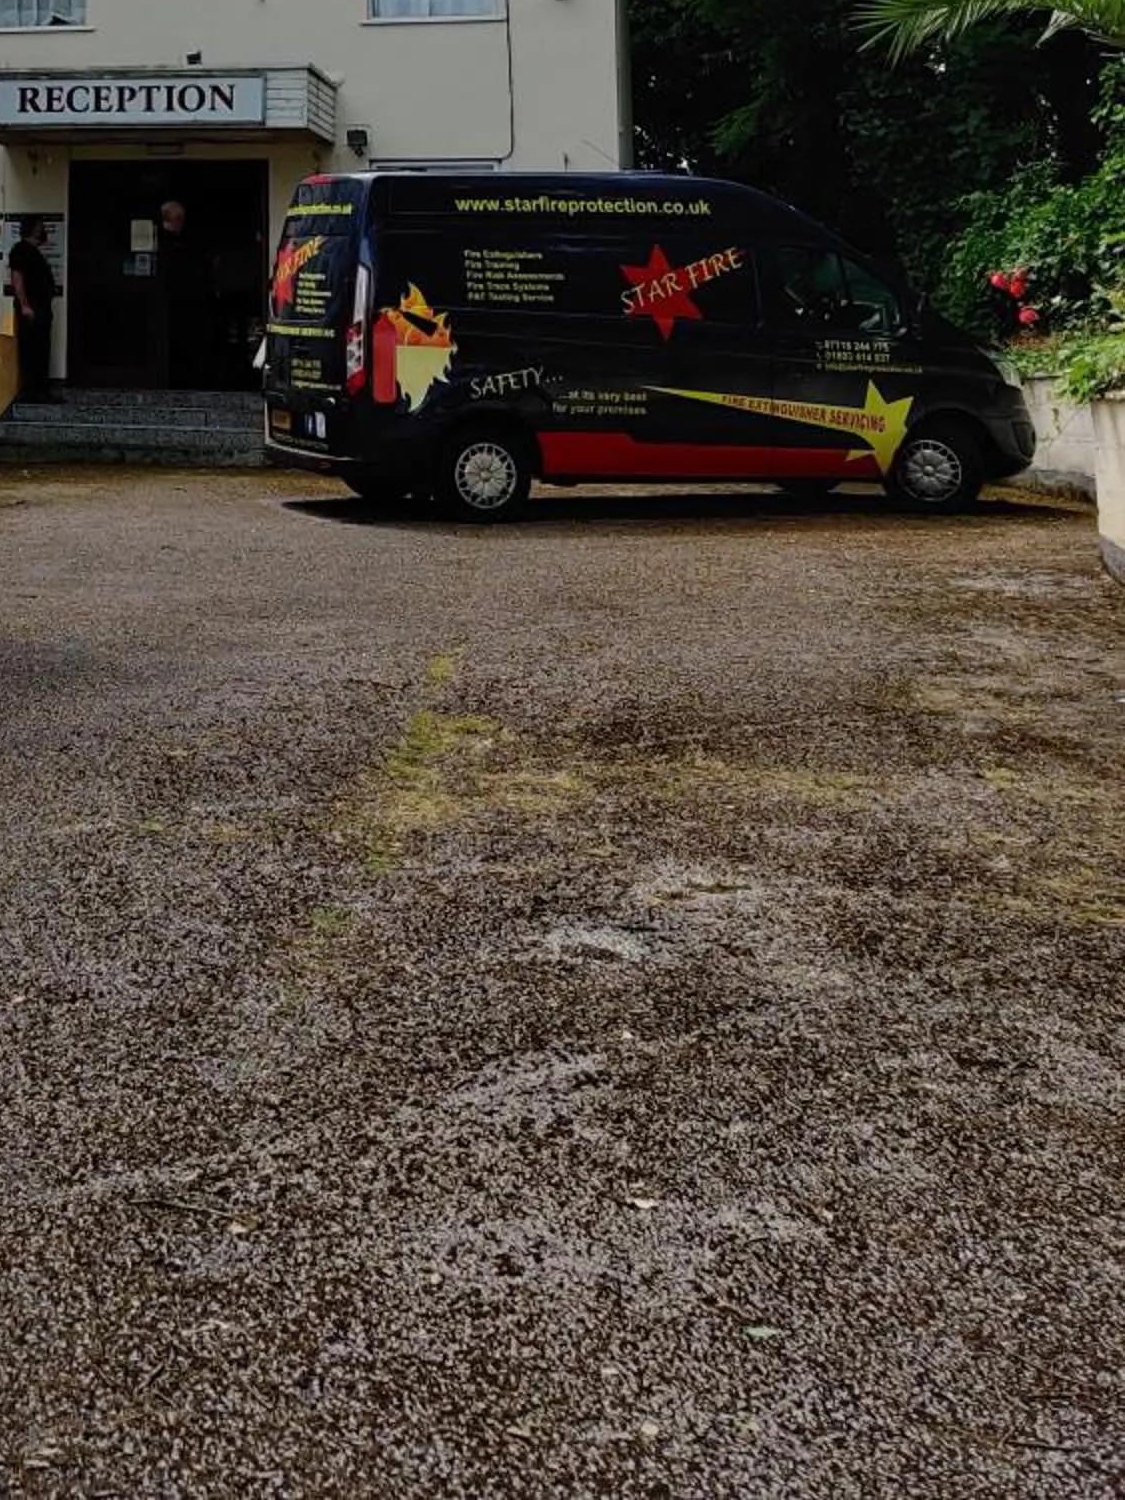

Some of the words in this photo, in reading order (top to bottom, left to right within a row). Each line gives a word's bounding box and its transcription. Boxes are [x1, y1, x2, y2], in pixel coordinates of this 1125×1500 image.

[17, 84, 235, 113] RECEPTION
[455, 196, 712, 216] www.starfireprotection.co.uk
[463, 250, 481, 259] Fire
[464, 260, 481, 269] Fire
[484, 260, 520, 271] Training
[466, 270, 484, 280] Fire
[485, 271, 504, 280] Risk
[619, 272, 684, 314] STAR
[685, 246, 743, 289] FIRE
[467, 281, 484, 291] Fire
[512, 282, 550, 292] Systems
[487, 292, 520, 303] Testing
[598, 392, 620, 403] very
[625, 391, 647, 401] best
[552, 402, 568, 413] for
[570, 404, 594, 414] your
[748, 398, 825, 423] EXTINGUISHER
[828, 409, 886, 432] SERVICING
